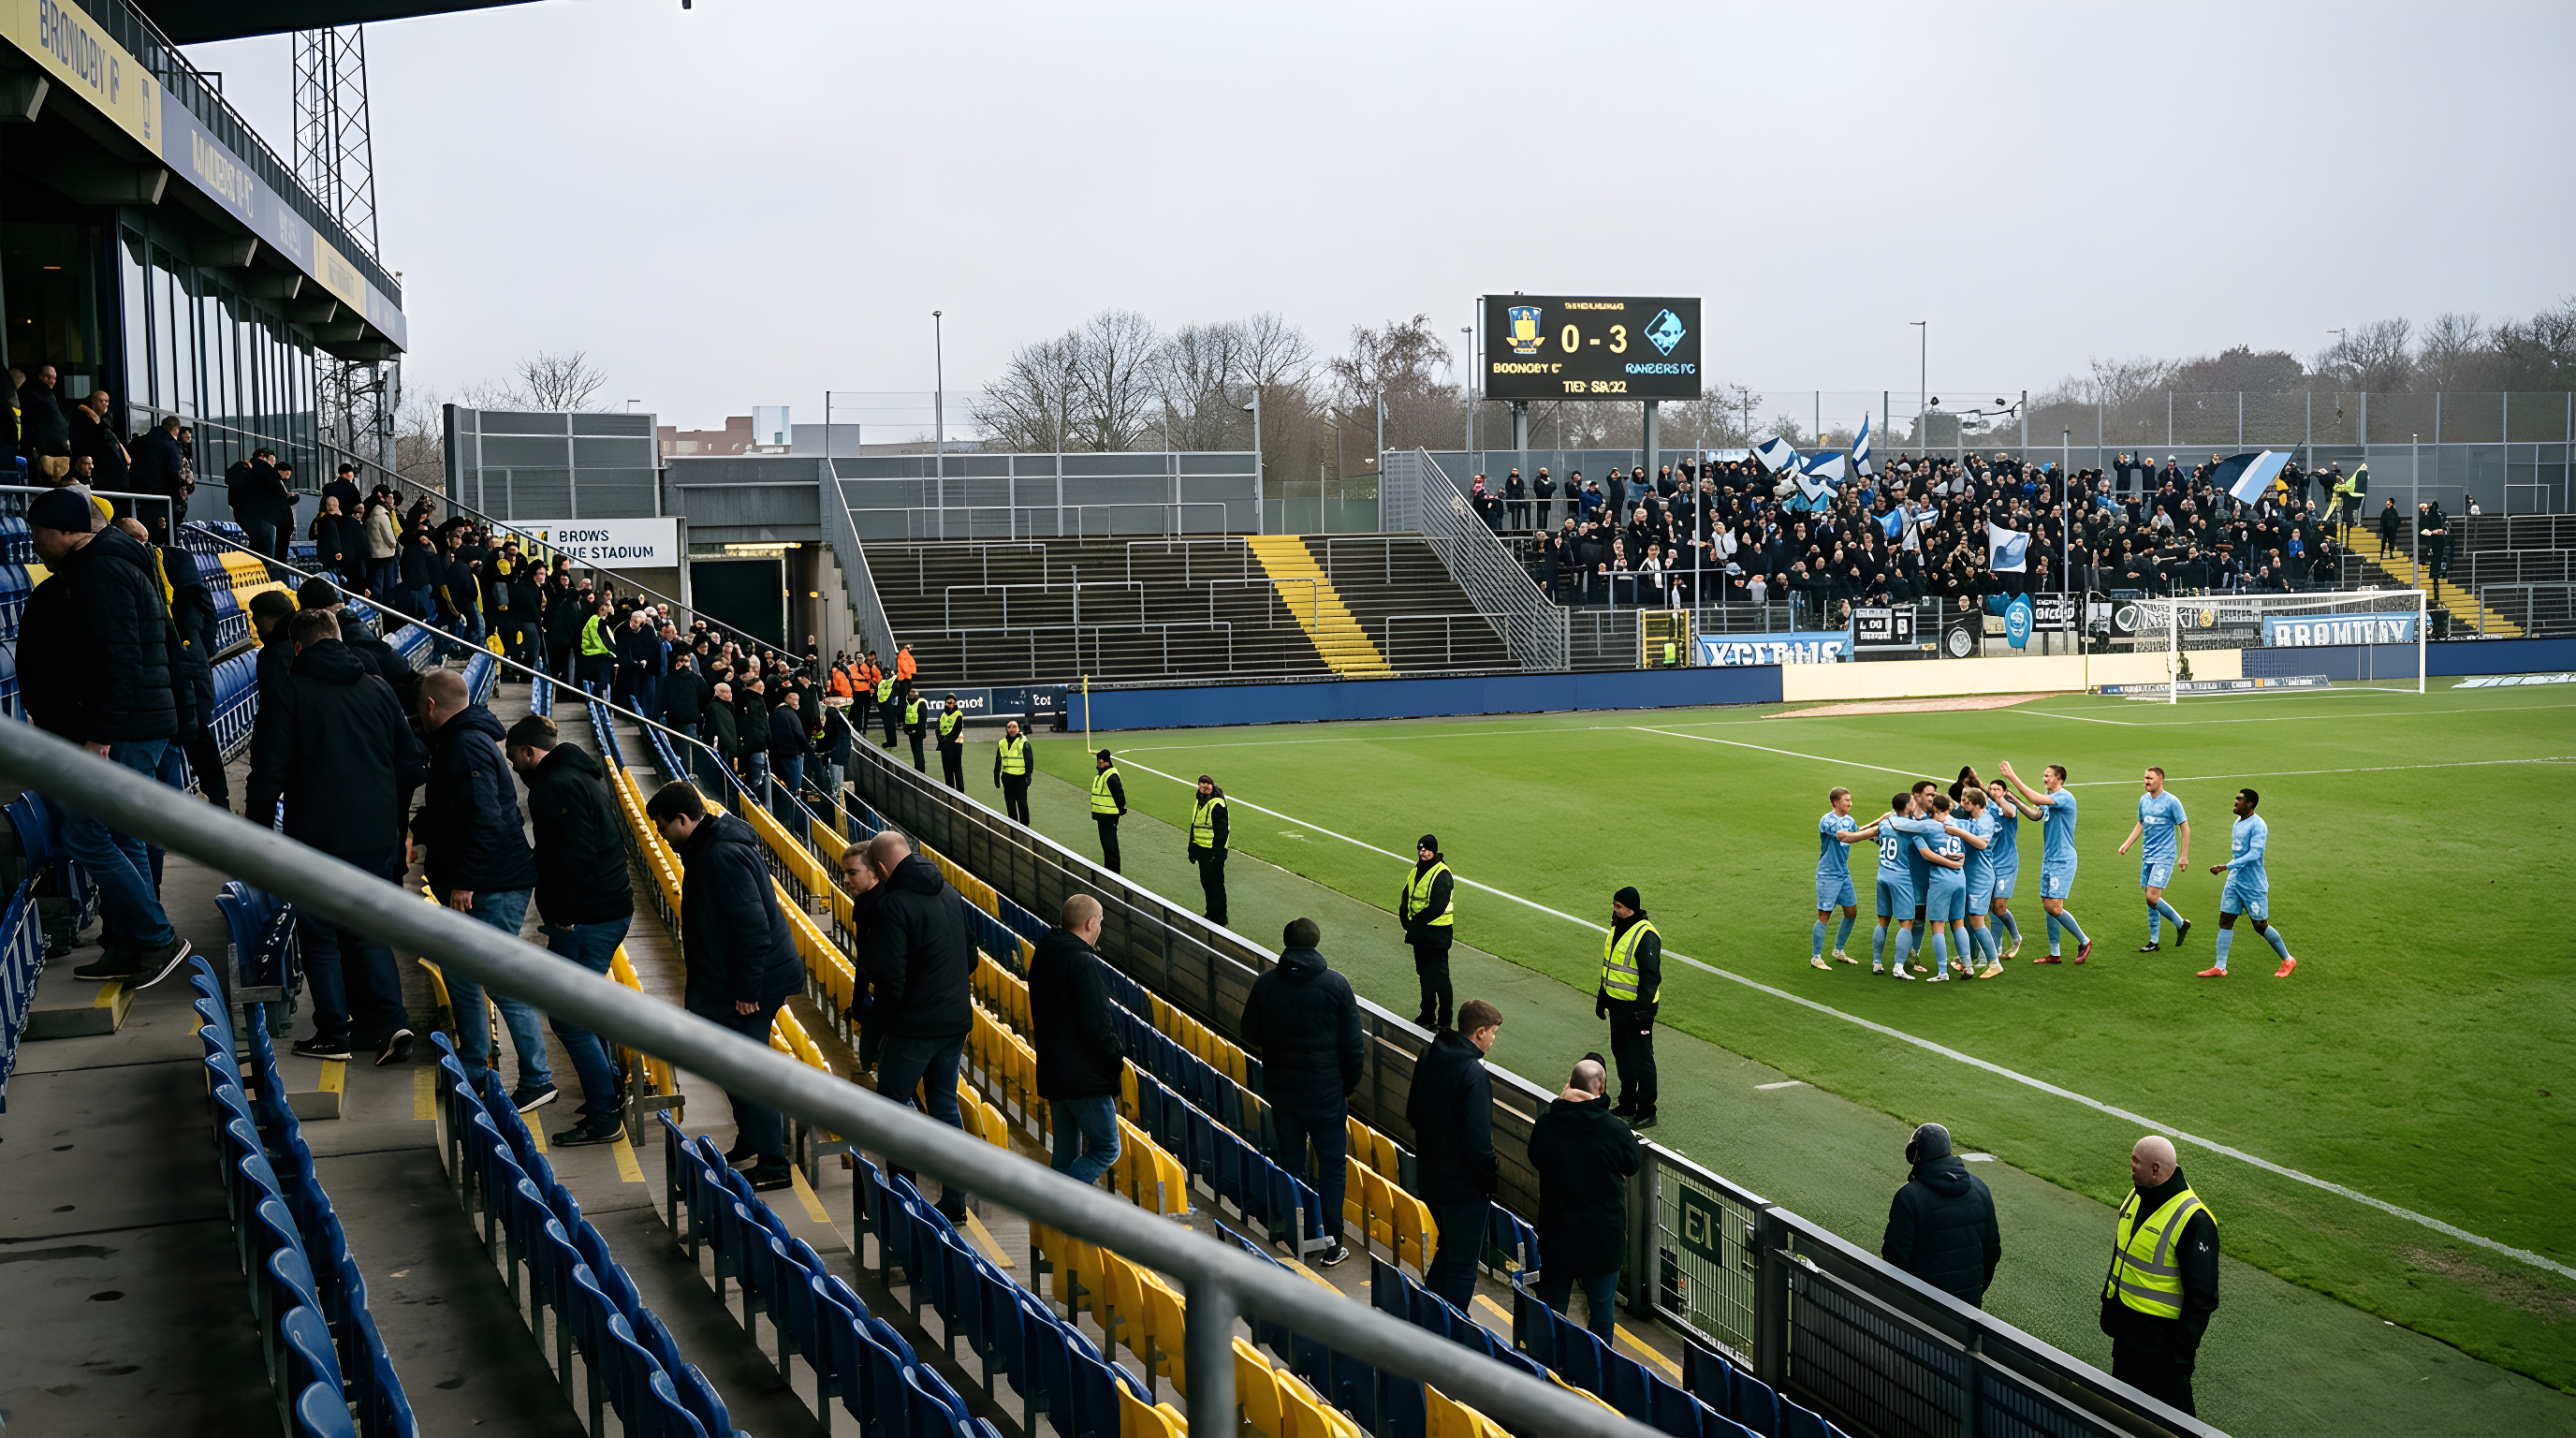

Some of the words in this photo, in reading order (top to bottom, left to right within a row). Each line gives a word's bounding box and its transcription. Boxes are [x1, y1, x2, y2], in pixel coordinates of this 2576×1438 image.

[1561, 324, 1580, 353] 0
[1609, 324, 1628, 354] 3
[559, 530, 609, 542] BROWS
[592, 546, 654, 559] STADIUM
